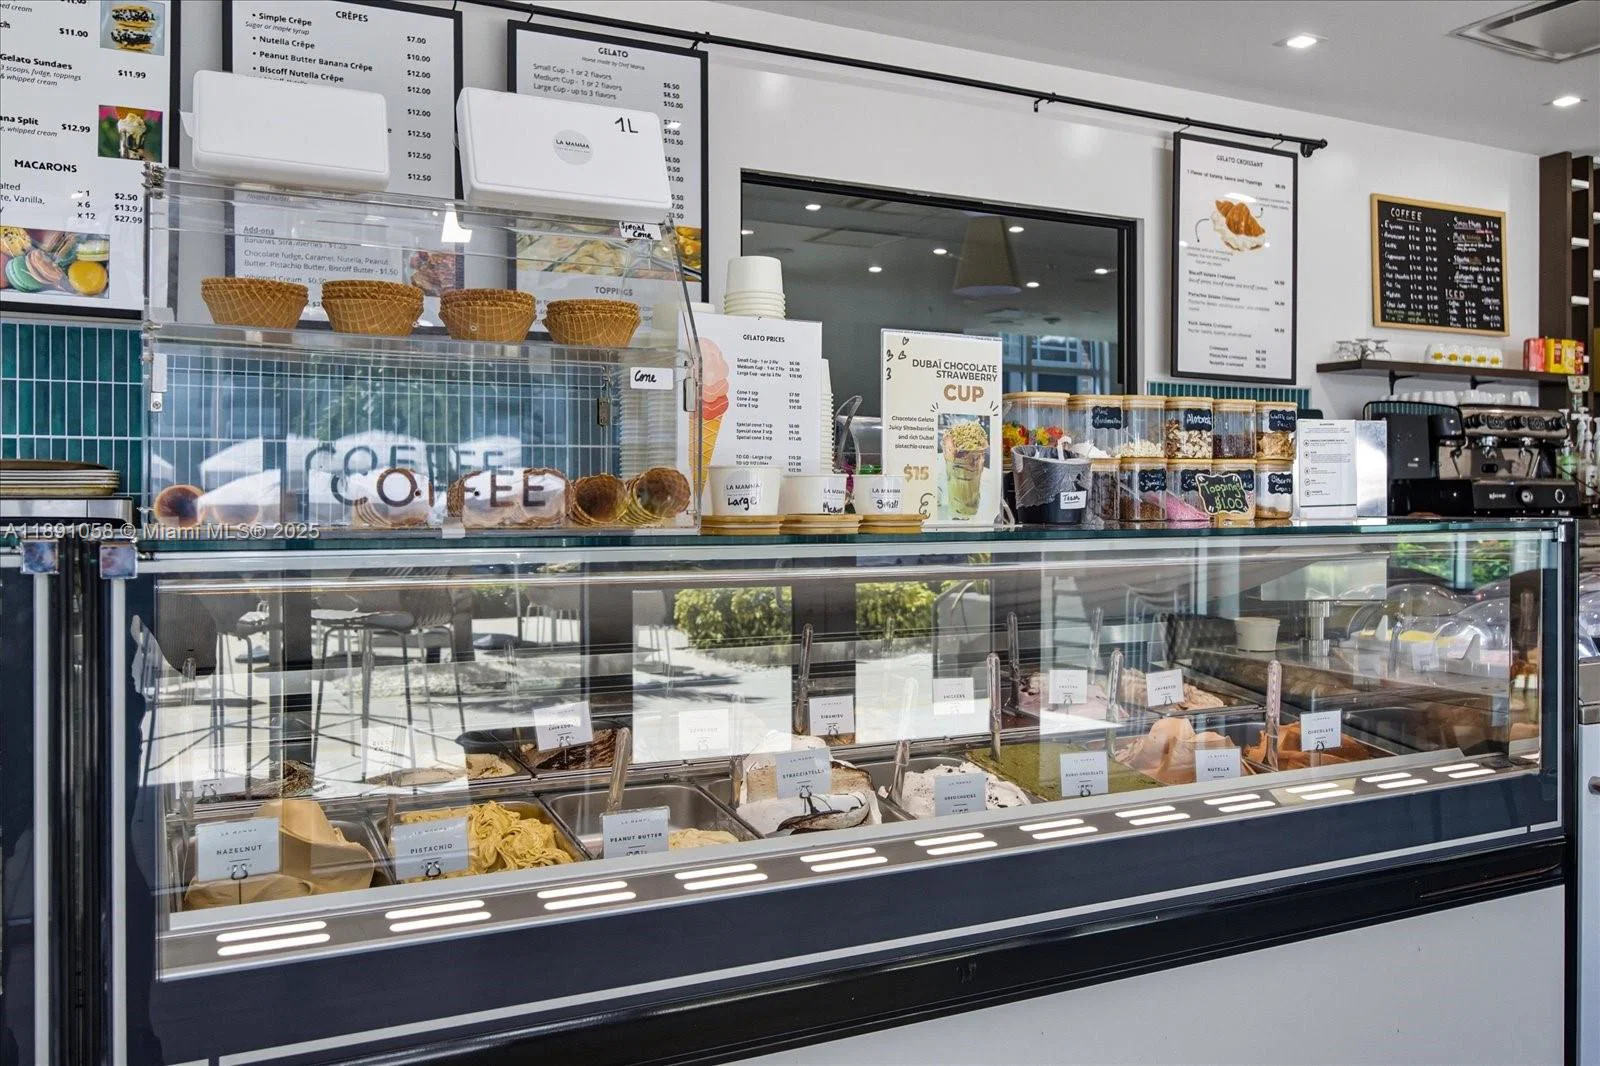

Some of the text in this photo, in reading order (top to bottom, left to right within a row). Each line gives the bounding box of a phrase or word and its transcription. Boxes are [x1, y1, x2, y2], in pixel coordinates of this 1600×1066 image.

[258, 12, 313, 27] Simple Crêpe
[336, 10, 369, 22] CRÊPES
[59, 28, 88, 38] $11.00
[260, 36, 316, 50] Nutella Crêpe
[407, 36, 426, 44] $7.00
[407, 54, 430, 62] $10.00
[598, 47, 629, 58] GELATO
[0, 53, 73, 70] Gelato Sundaes
[260, 50, 373, 72] Peanut Butter Banana Crêpe
[54, 72, 82, 82] toppings
[118, 69, 146, 80] $11.99
[260, 66, 288, 76] Biscoff
[289, 69, 319, 80] Nutella
[320, 73, 344, 83] Crêpe
[407, 70, 431, 78] $12.00
[532, 63, 552, 71] Small
[552, 66, 566, 74] Cup
[590, 72, 612, 80] flavors
[6, 74, 36, 84] whipped
[534, 73, 560, 82] Medium
[562, 77, 574, 85] Cup
[601, 82, 622, 92] flavors
[407, 86, 432, 95] $12.00
[534, 83, 552, 92] Large
[552, 86, 566, 94] Cup
[595, 91, 616, 100] flavors
[407, 108, 432, 117] $12.00
[18, 116, 39, 126] Split
[8, 126, 58, 138] whipped cream
[61, 123, 91, 134] $12.99
[407, 130, 432, 139] $12.50
[407, 152, 432, 160] $12.50
[14, 159, 78, 173] MACARONS
[407, 173, 432, 182] $12.50
[114, 192, 138, 202] $2.50
[86, 212, 96, 220] 12
[114, 214, 143, 224] $27.99
[1390, 207, 1422, 221] COFFEE
[766, 335, 786, 344] PRICES
[943, 361, 998, 374] CHOCOLATE
[634, 368, 657, 383] Cone
[936, 370, 998, 382] STRAWBERRY
[944, 384, 984, 402] CUP
[904, 464, 930, 482] $15
[1200, 482, 1244, 498] Toppings
[728, 496, 758, 511] Large
[1214, 496, 1244, 512] $1.00
[638, 832, 663, 840] BUTTER
[216, 844, 262, 856] HAZELNUT
[410, 844, 453, 854] PISTACHIO
